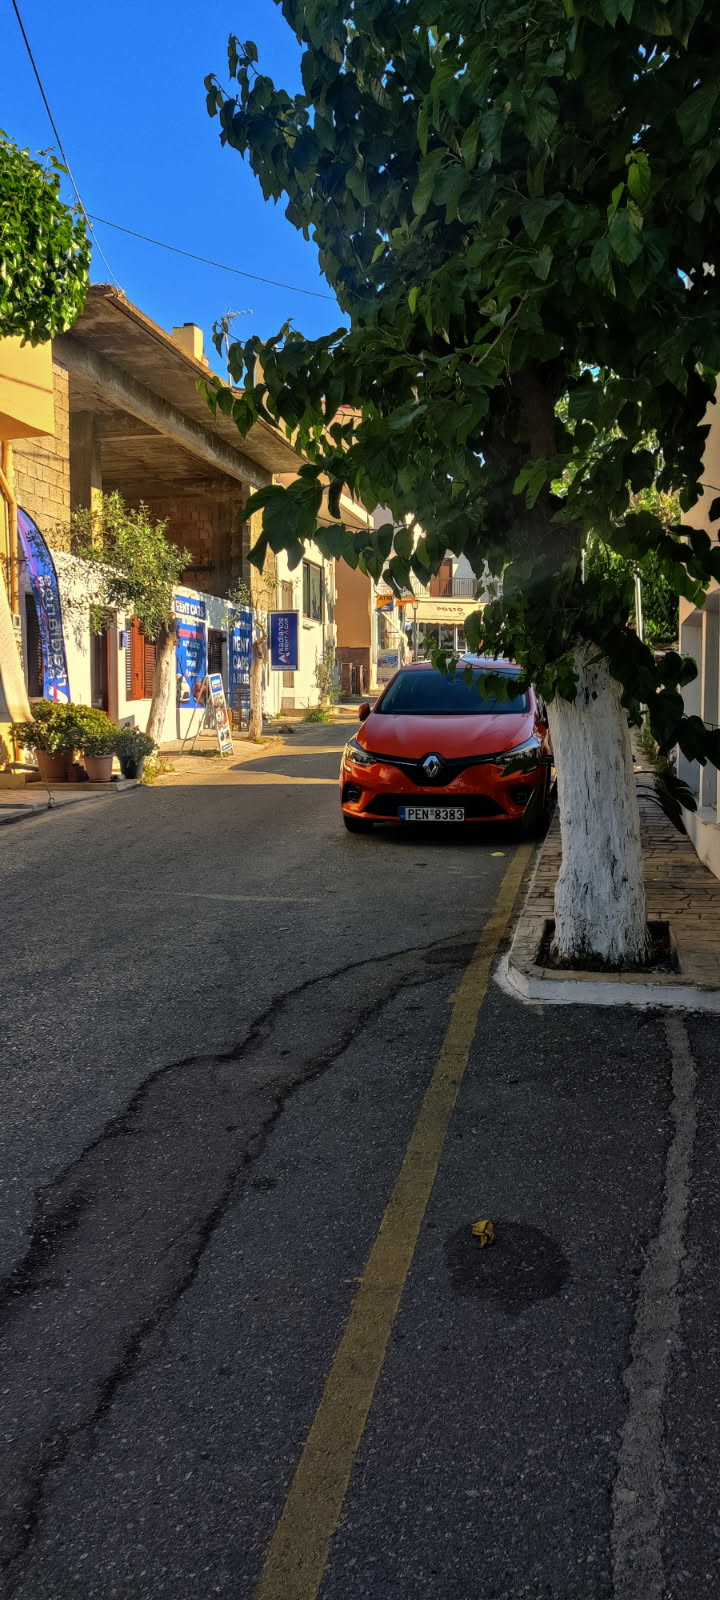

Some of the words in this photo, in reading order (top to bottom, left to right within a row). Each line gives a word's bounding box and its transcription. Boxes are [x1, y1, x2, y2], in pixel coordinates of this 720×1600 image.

[190, 603, 205, 618] CARS
[232, 635, 250, 653] RENT
[232, 654, 250, 670] CARS
